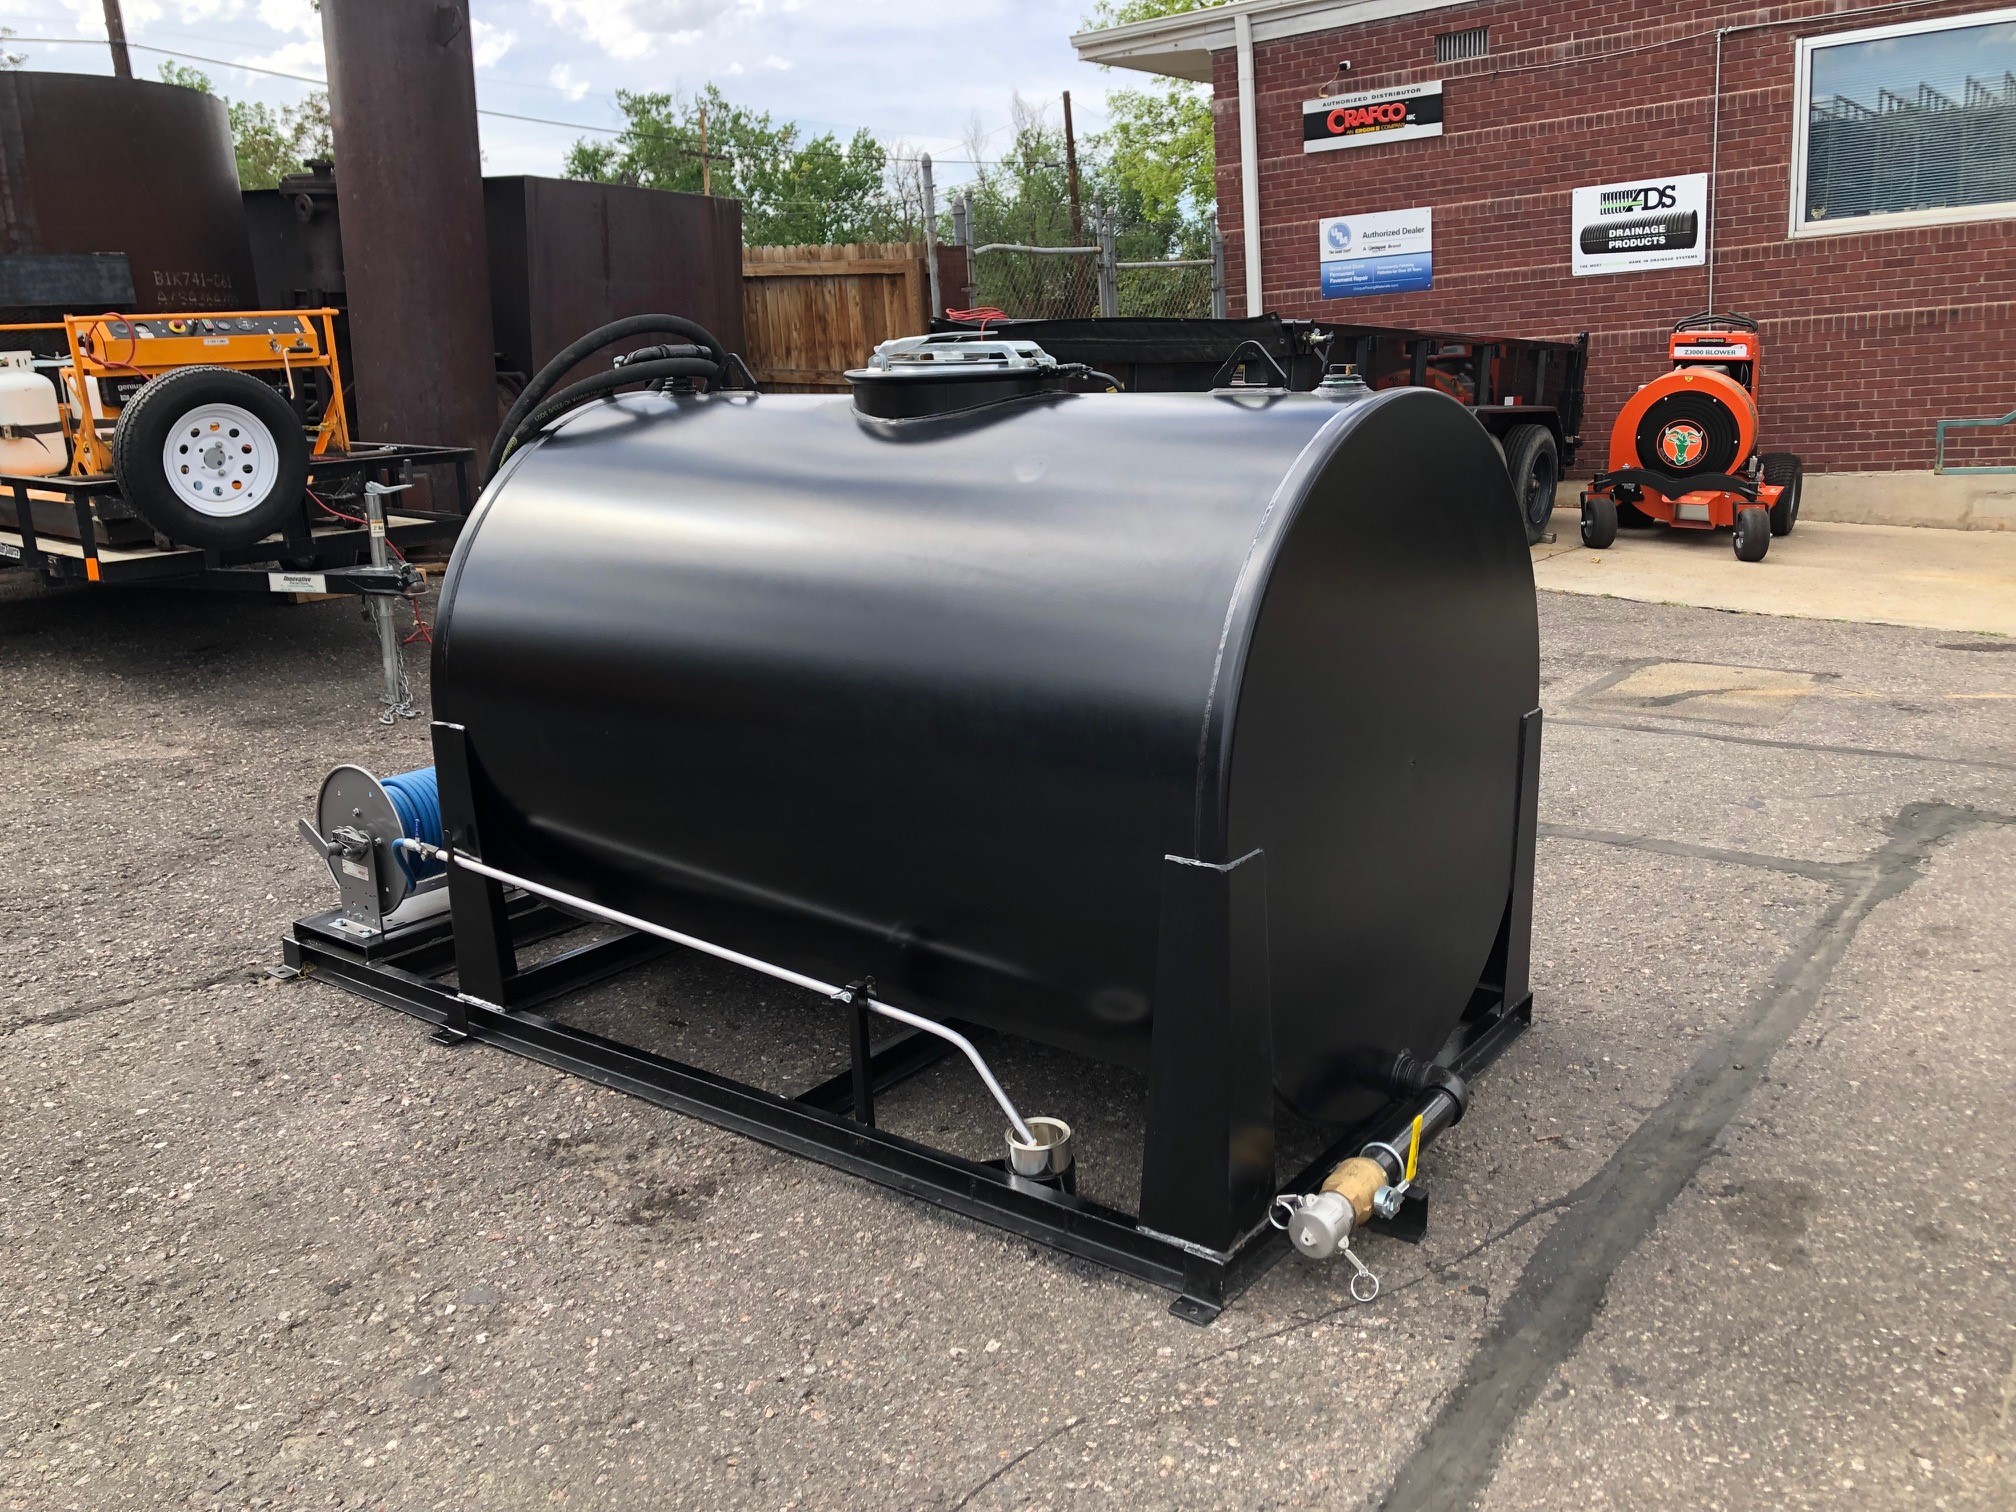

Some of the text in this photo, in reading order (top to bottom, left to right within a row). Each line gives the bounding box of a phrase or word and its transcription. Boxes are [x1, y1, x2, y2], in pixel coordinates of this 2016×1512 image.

[1322, 88, 1421, 107] AUTHORIZED DISTRIBUTOR
[1327, 102, 1406, 134] CRAFCO
[1362, 226, 1425, 239] Authorized Dealer
[1609, 224, 1666, 238] DRAINAGE
[1608, 236, 1666, 249] PRODUCTS
